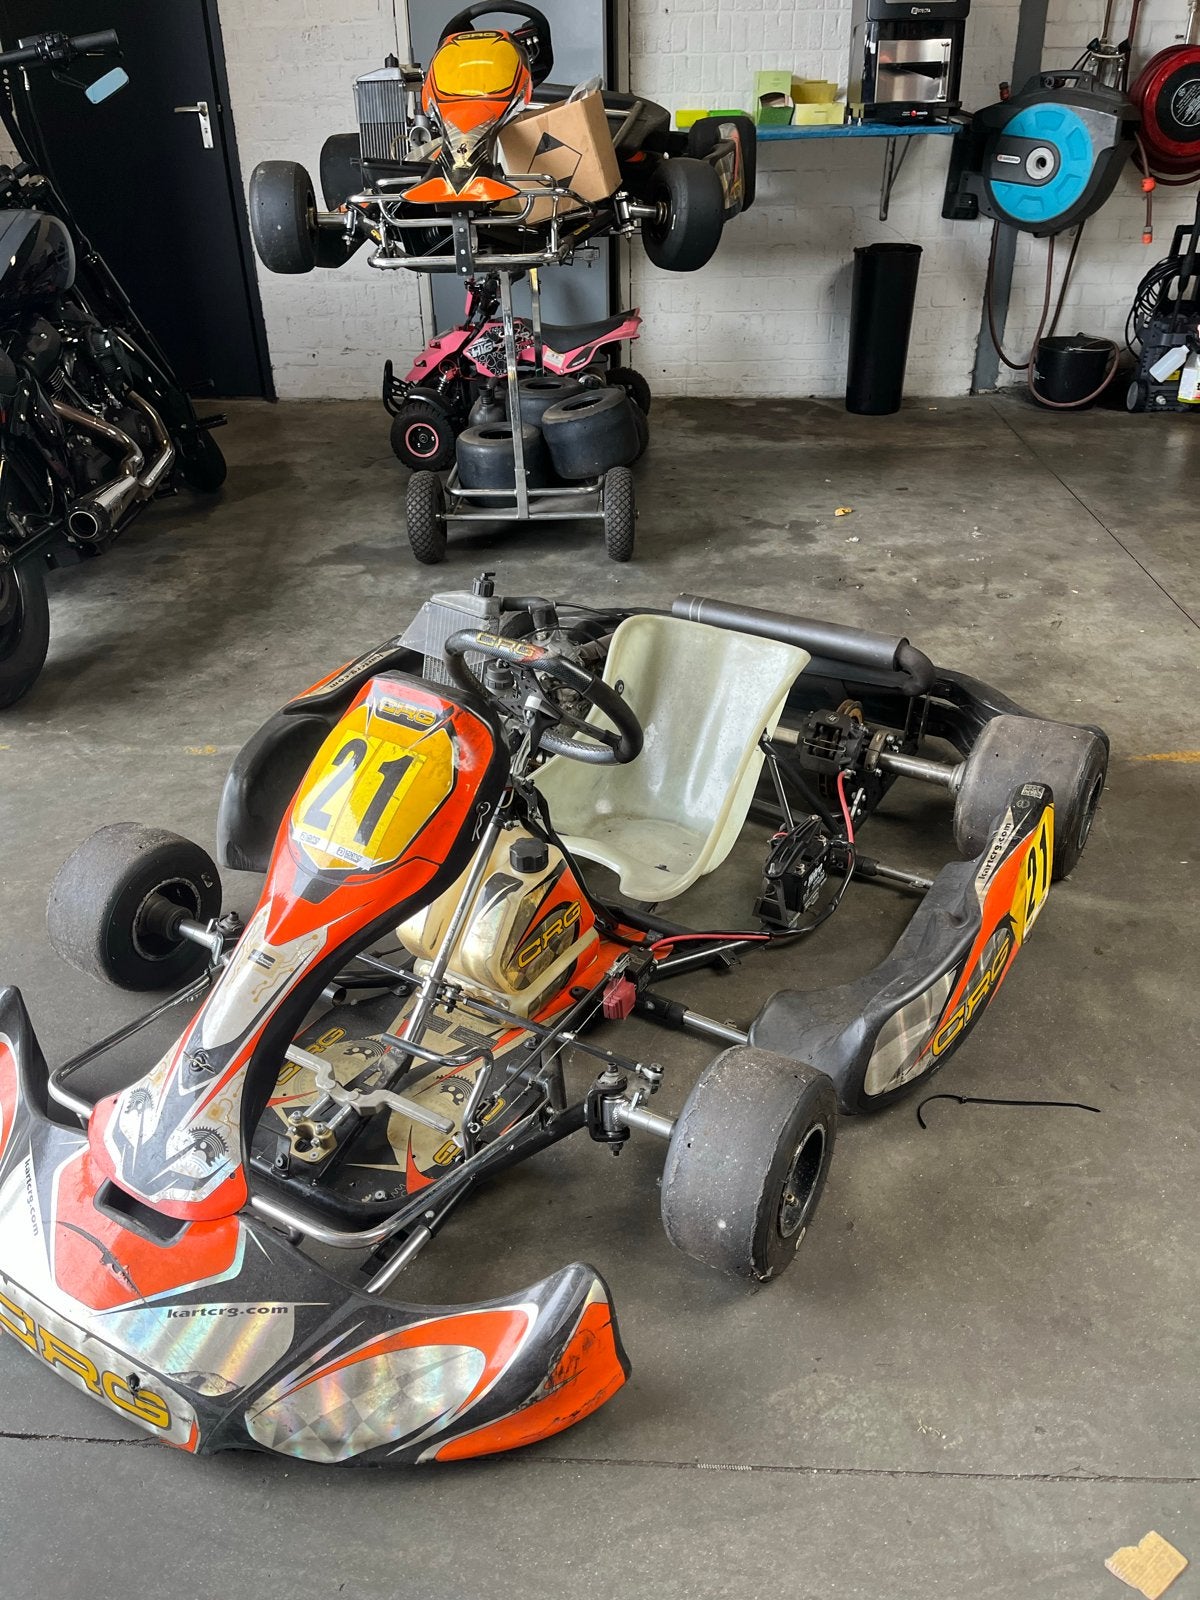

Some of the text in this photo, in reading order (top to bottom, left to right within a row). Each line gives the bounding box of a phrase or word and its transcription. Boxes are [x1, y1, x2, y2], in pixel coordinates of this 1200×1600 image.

[476, 632, 536, 657] CRG
[378, 696, 437, 726] CRG
[303, 738, 415, 847] 21
[978, 822, 1012, 880] kartcrg.com
[1025, 822, 1048, 920] 21
[518, 900, 582, 968] CRG
[932, 936, 1010, 1057] CRG
[24, 1158, 40, 1237] kartcrg.com
[167, 1306, 290, 1319] kartcrg.com
